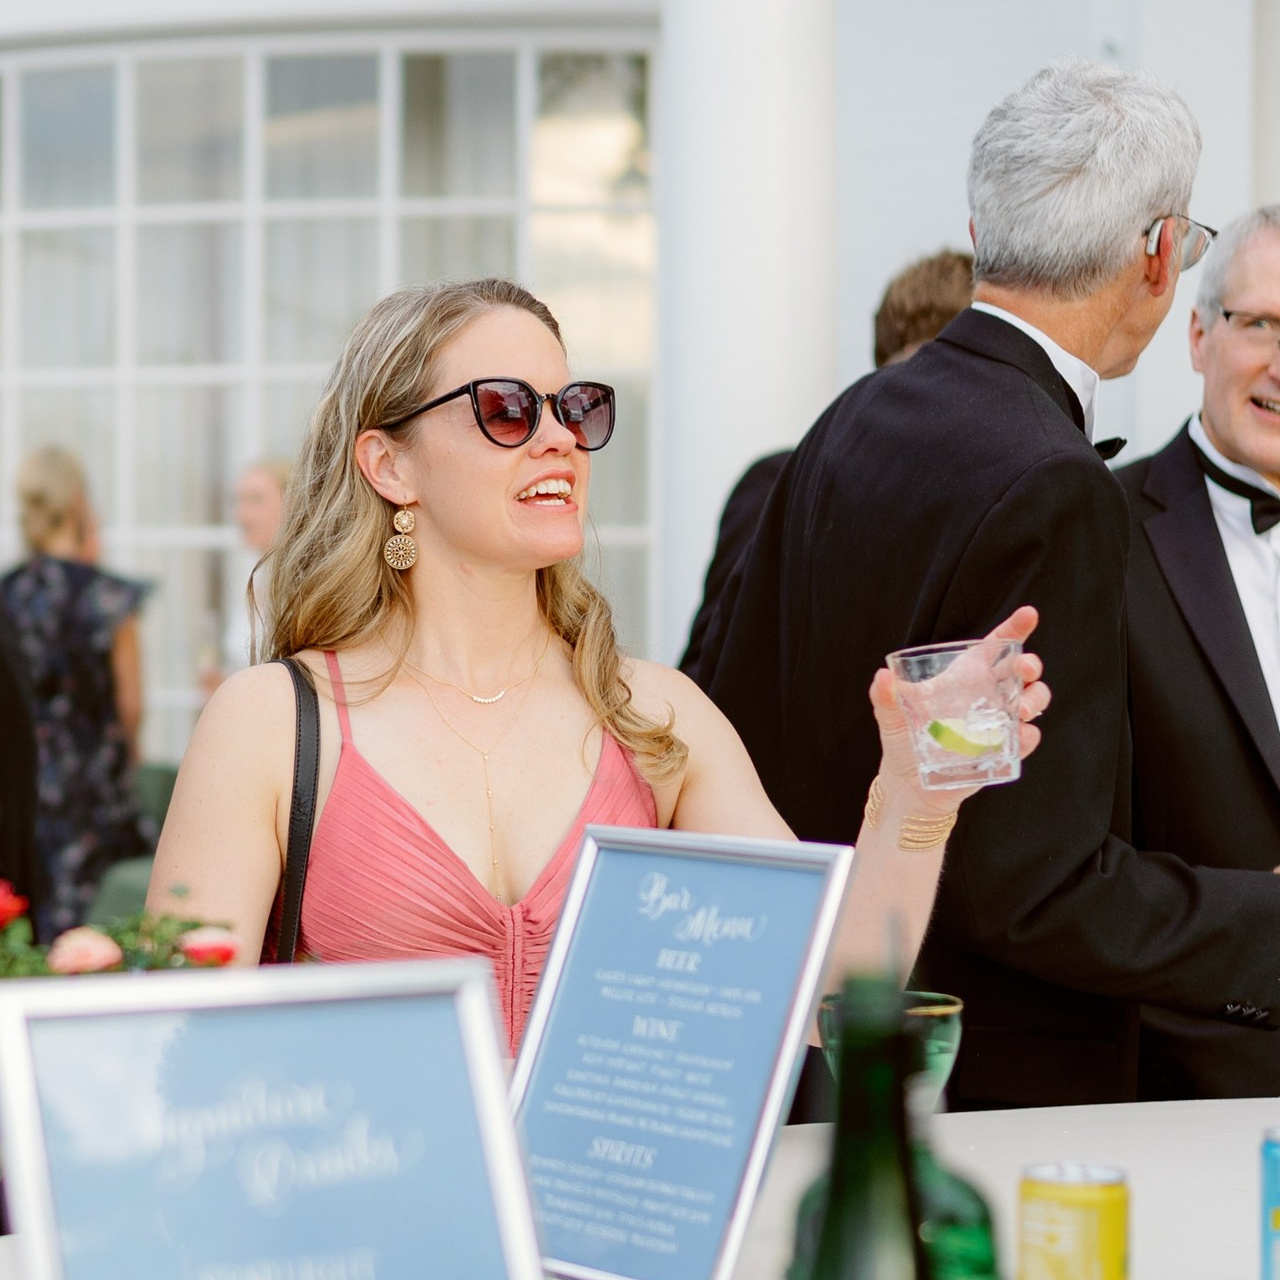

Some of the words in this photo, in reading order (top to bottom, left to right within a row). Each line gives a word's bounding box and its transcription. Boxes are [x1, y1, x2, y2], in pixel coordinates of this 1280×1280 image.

[640, 872, 690, 916] Bar
[677, 907, 763, 943] Menu
[657, 950, 700, 972] BEER
[634, 1017, 683, 1042] WINE
[589, 1139, 656, 1168] SPIRITS
